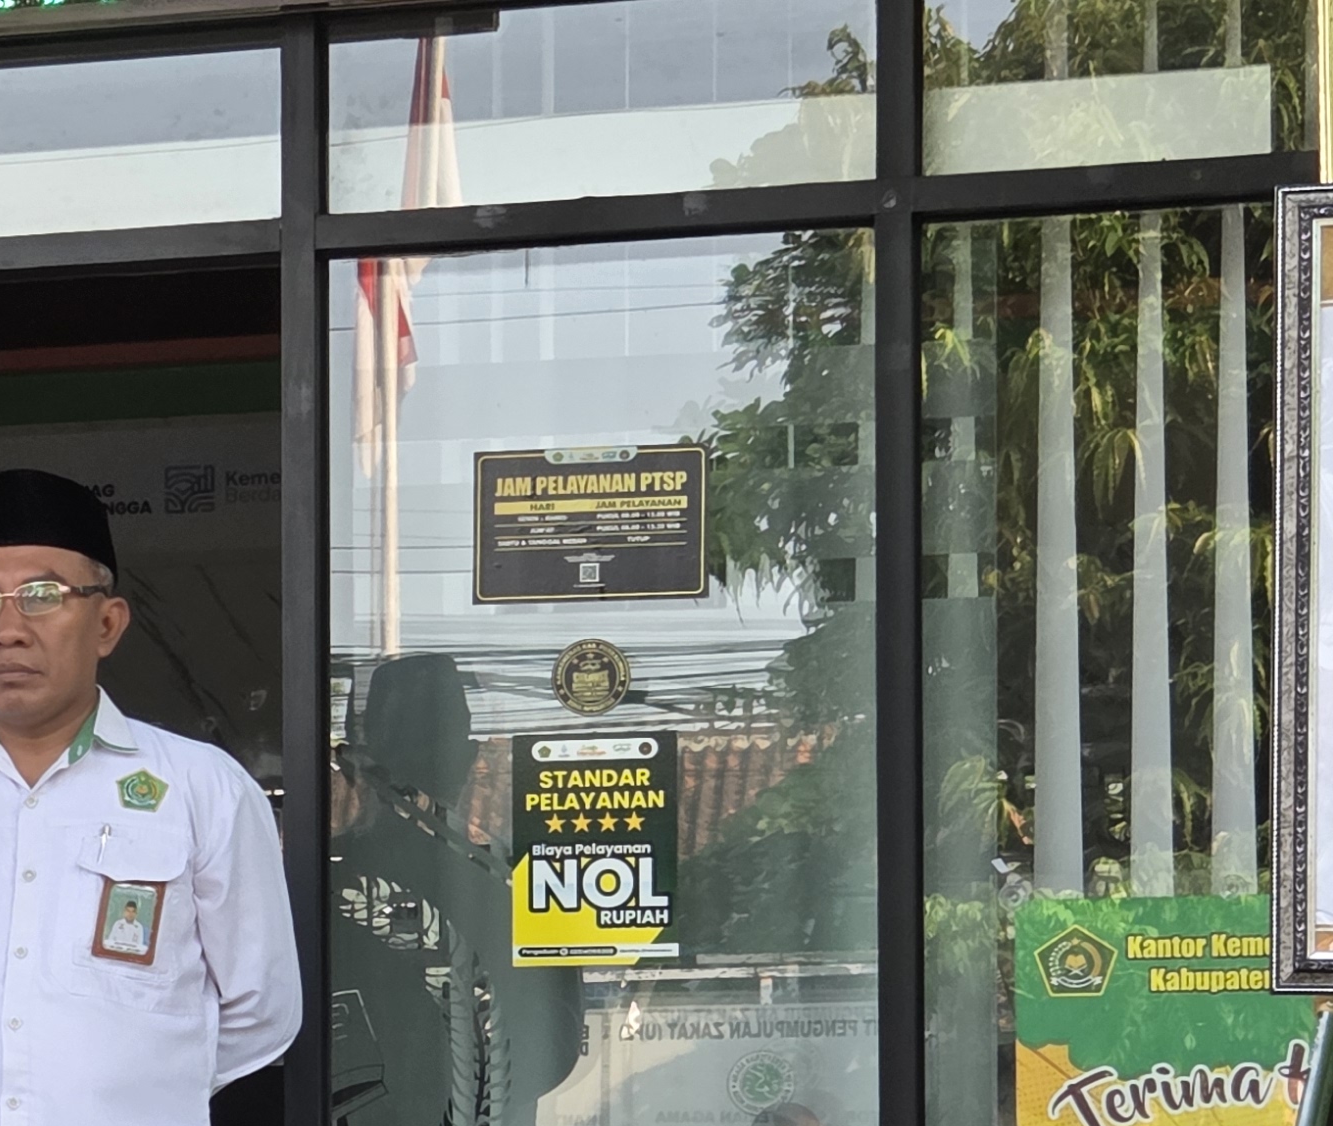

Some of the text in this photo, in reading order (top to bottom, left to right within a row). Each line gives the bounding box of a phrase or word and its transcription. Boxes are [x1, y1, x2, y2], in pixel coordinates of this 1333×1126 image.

[225, 470, 282, 487] Keme
[495, 471, 688, 498] JAM PELAYANAN PTSP
[529, 502, 555, 512] HARI
[595, 499, 682, 510] JAM PELAYANAN
[538, 769, 651, 790] STANDAR
[525, 790, 665, 812] PELAYANAN
[531, 842, 651, 859] Biaya Pelayanan
[532, 856, 670, 910] NOL
[600, 910, 670, 925] RUPIAH
[1127, 935, 1206, 960] Kantor
